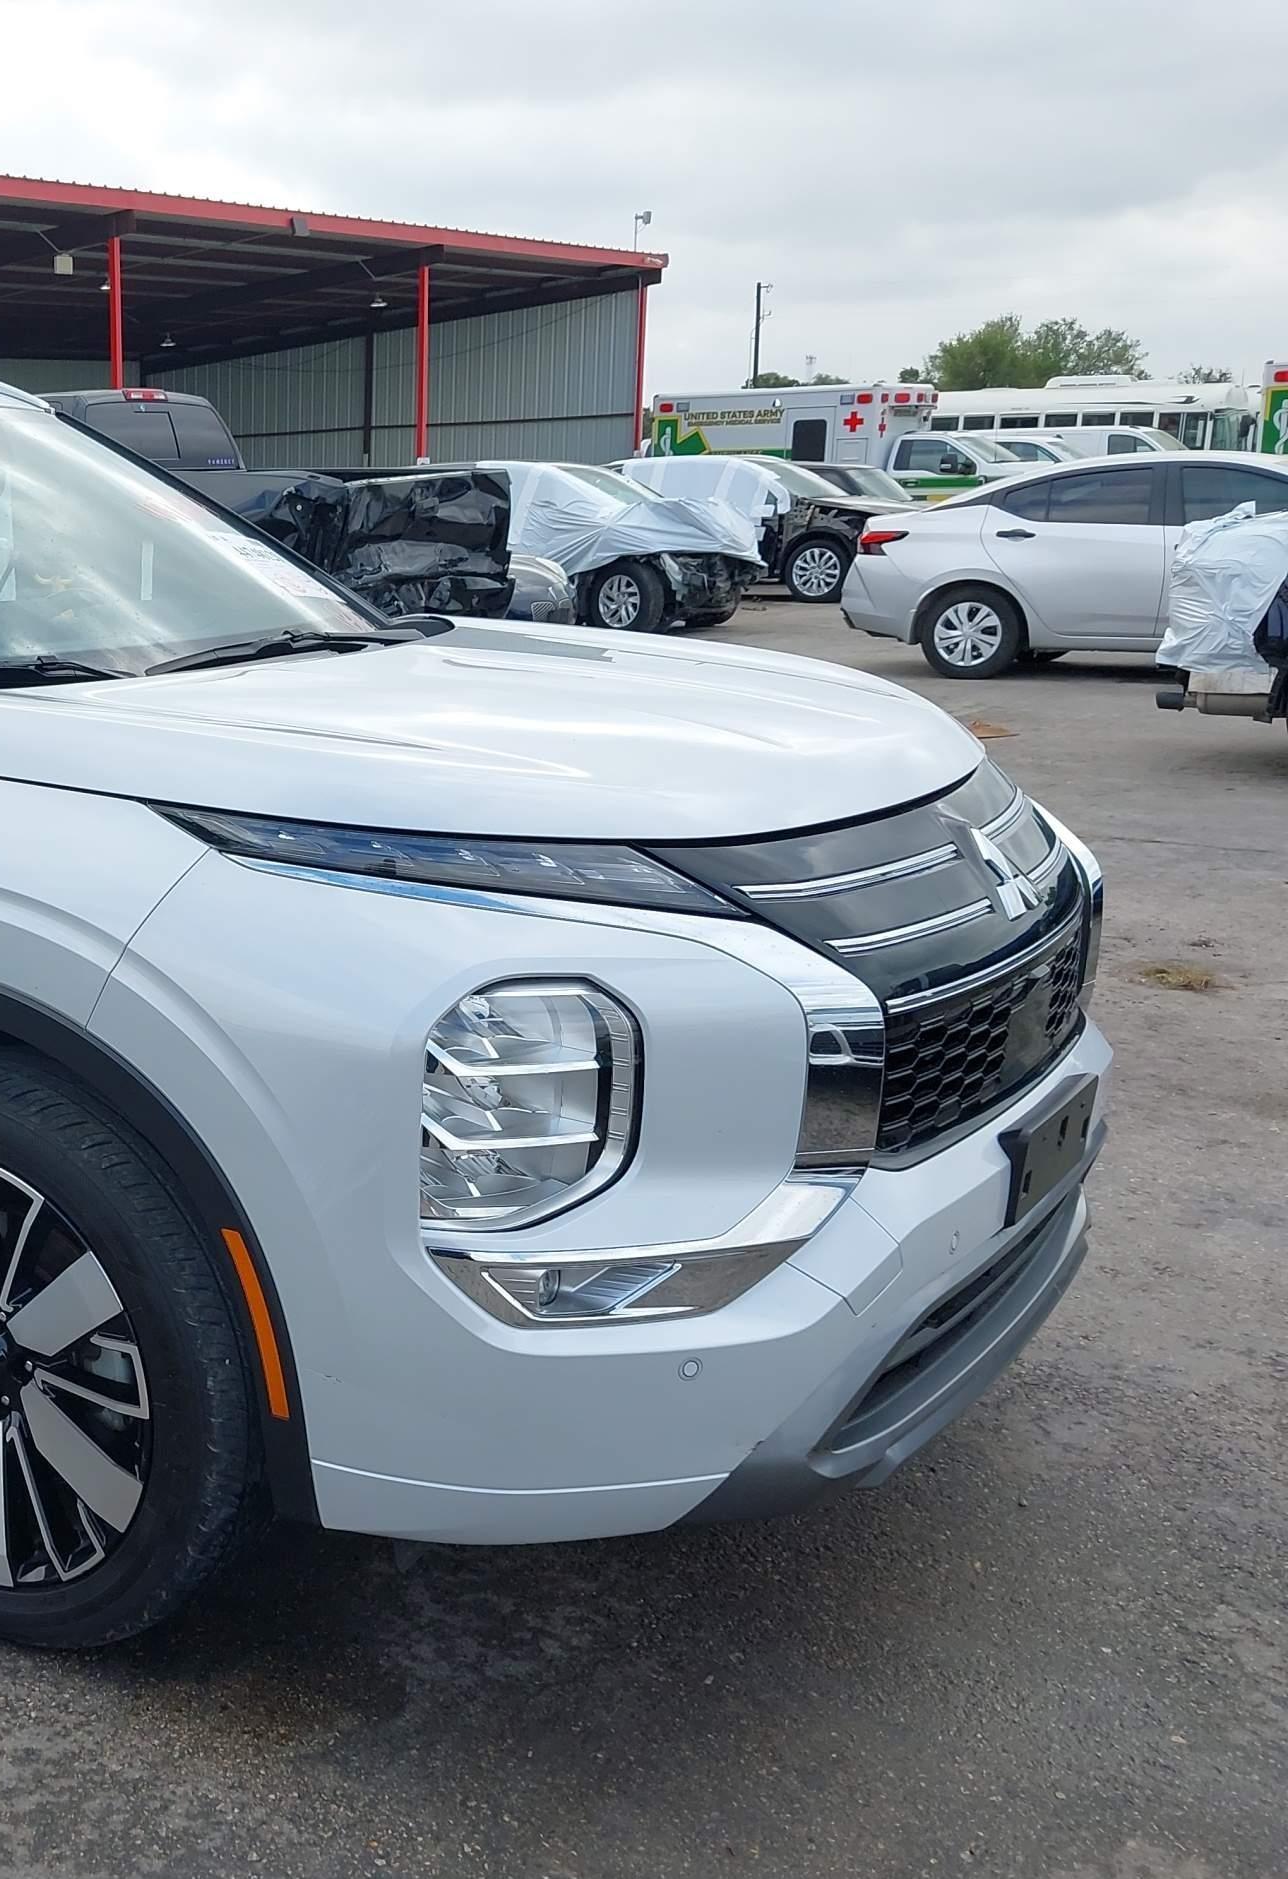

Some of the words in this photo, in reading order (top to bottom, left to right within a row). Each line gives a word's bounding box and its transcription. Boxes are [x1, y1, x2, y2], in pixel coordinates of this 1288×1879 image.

[684, 412, 719, 420] UNITED
[720, 410, 754, 419] STATES
[755, 408, 784, 417] ARMY
